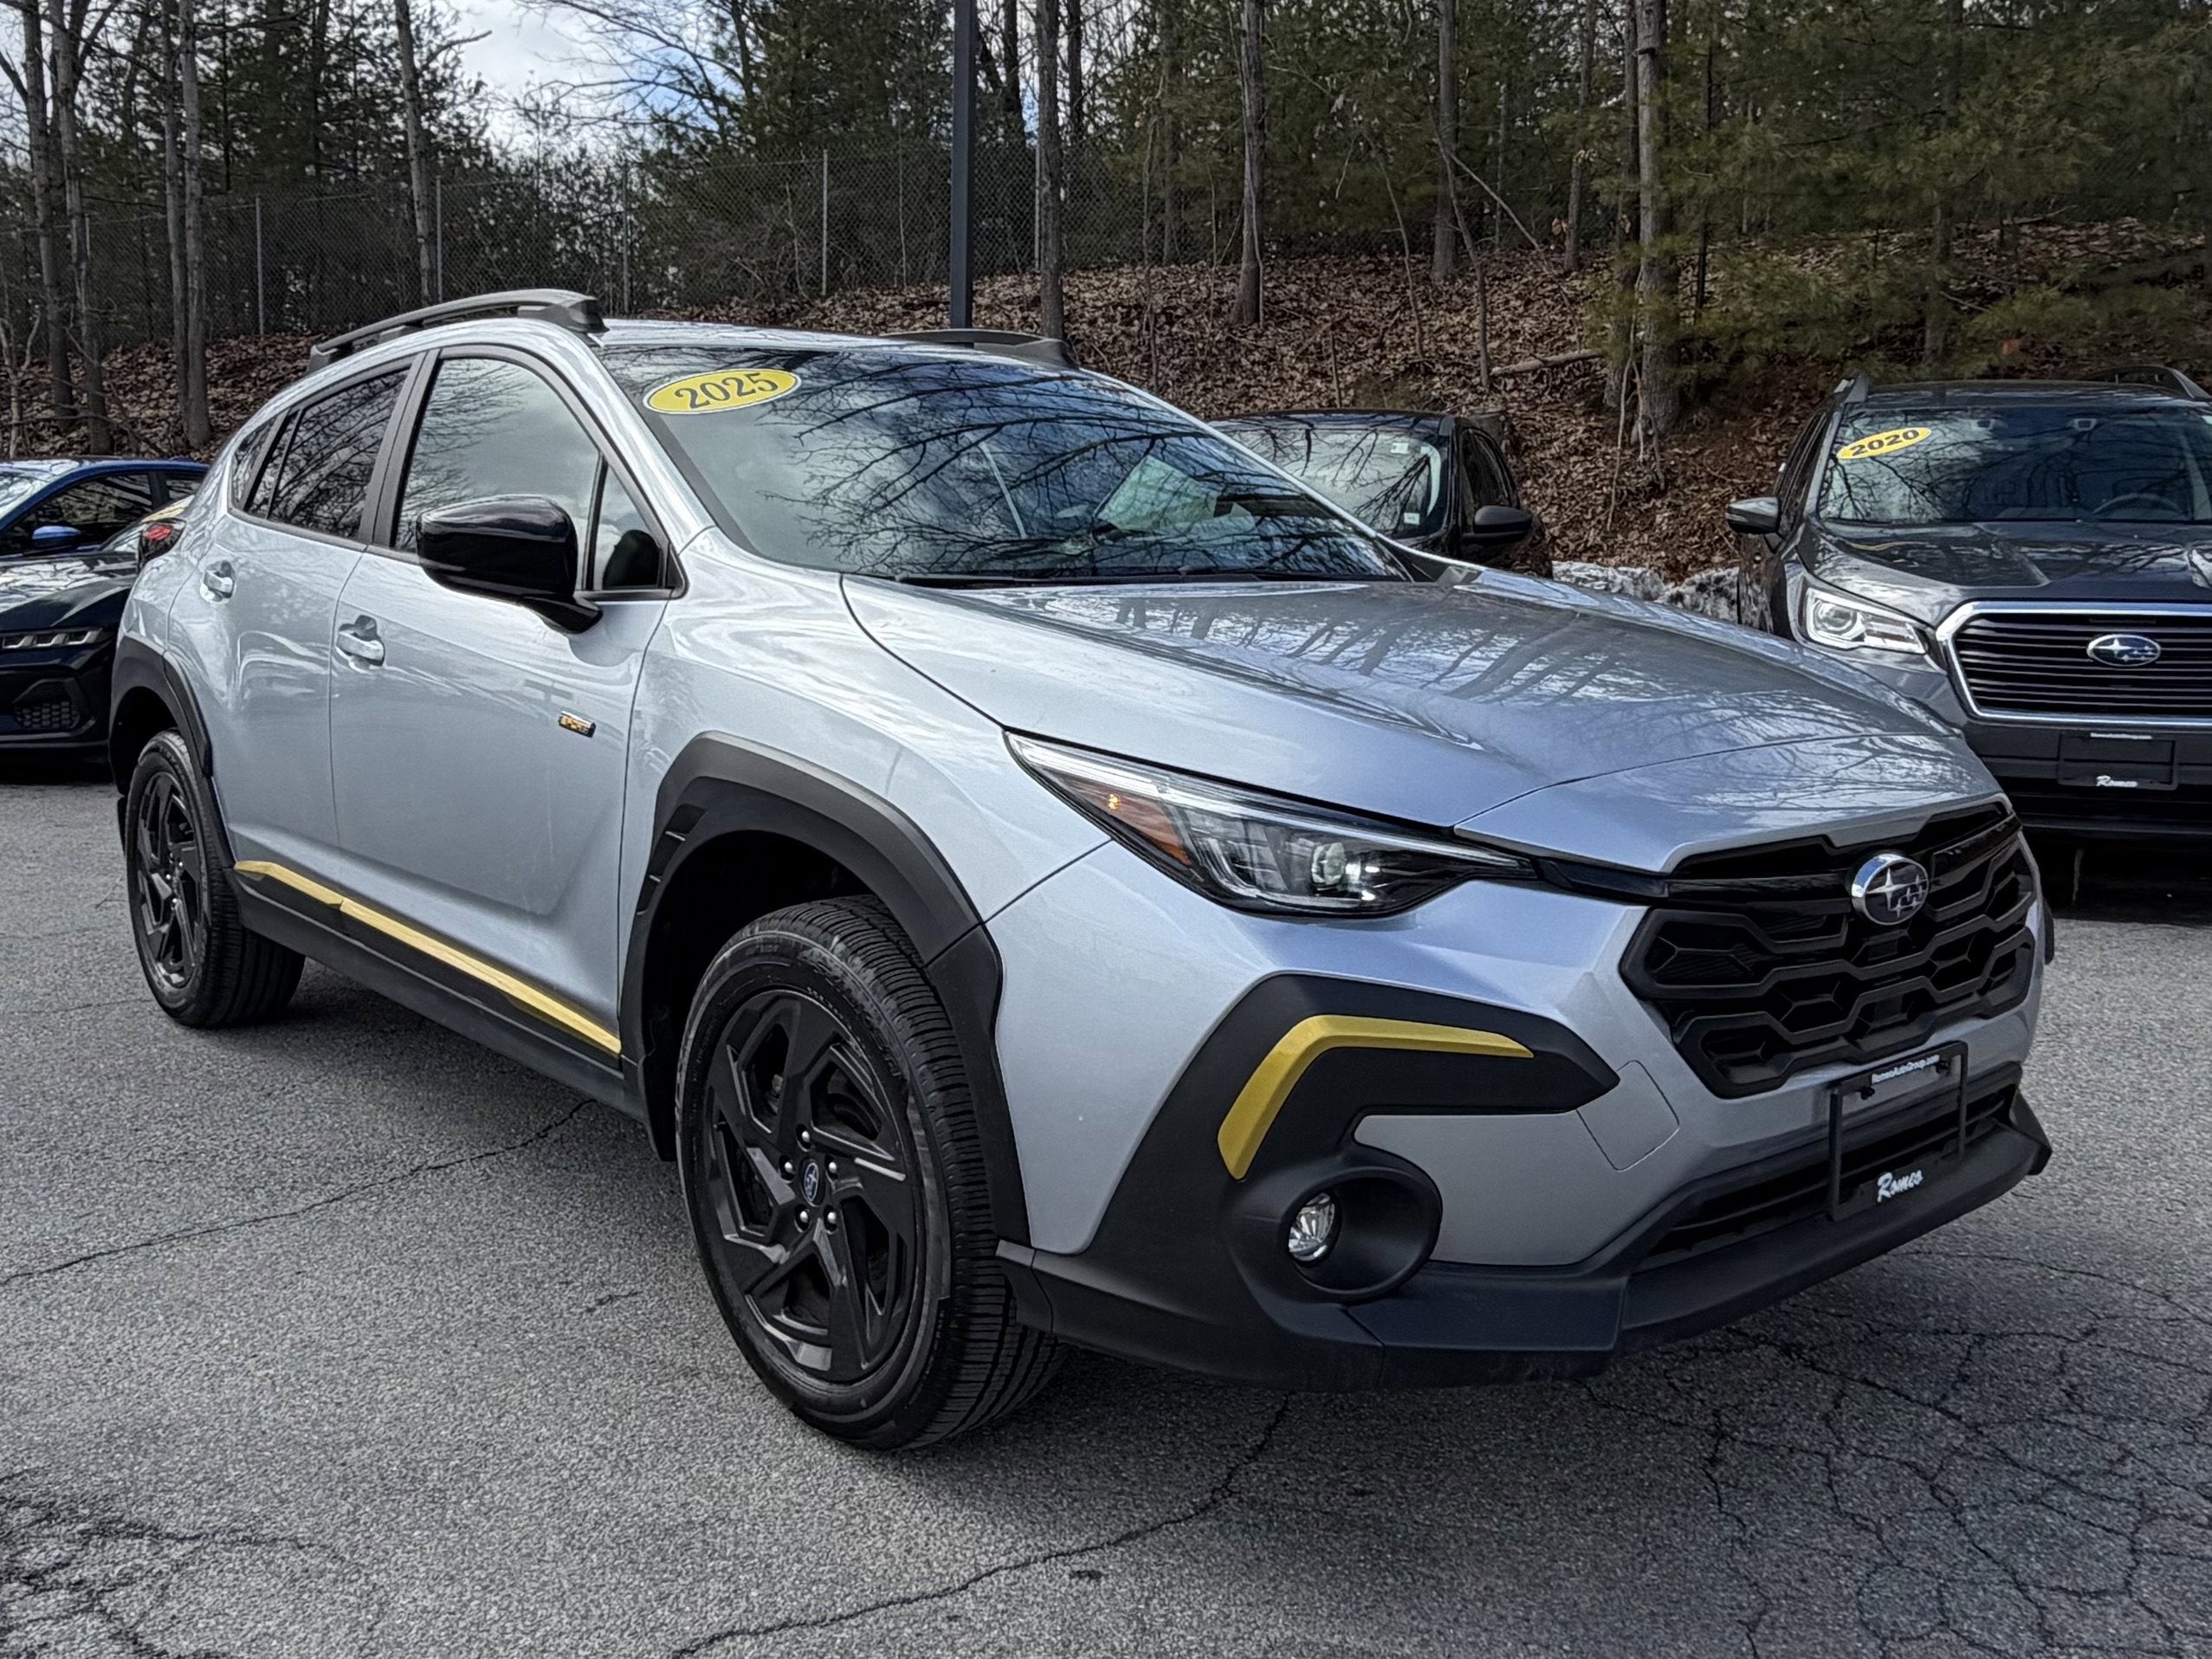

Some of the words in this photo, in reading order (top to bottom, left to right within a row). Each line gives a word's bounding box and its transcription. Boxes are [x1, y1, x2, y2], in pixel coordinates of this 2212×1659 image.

[675, 372, 779, 409] 2025
[1849, 429, 1920, 456] 2020
[1877, 1170, 1924, 1203] Romeo
